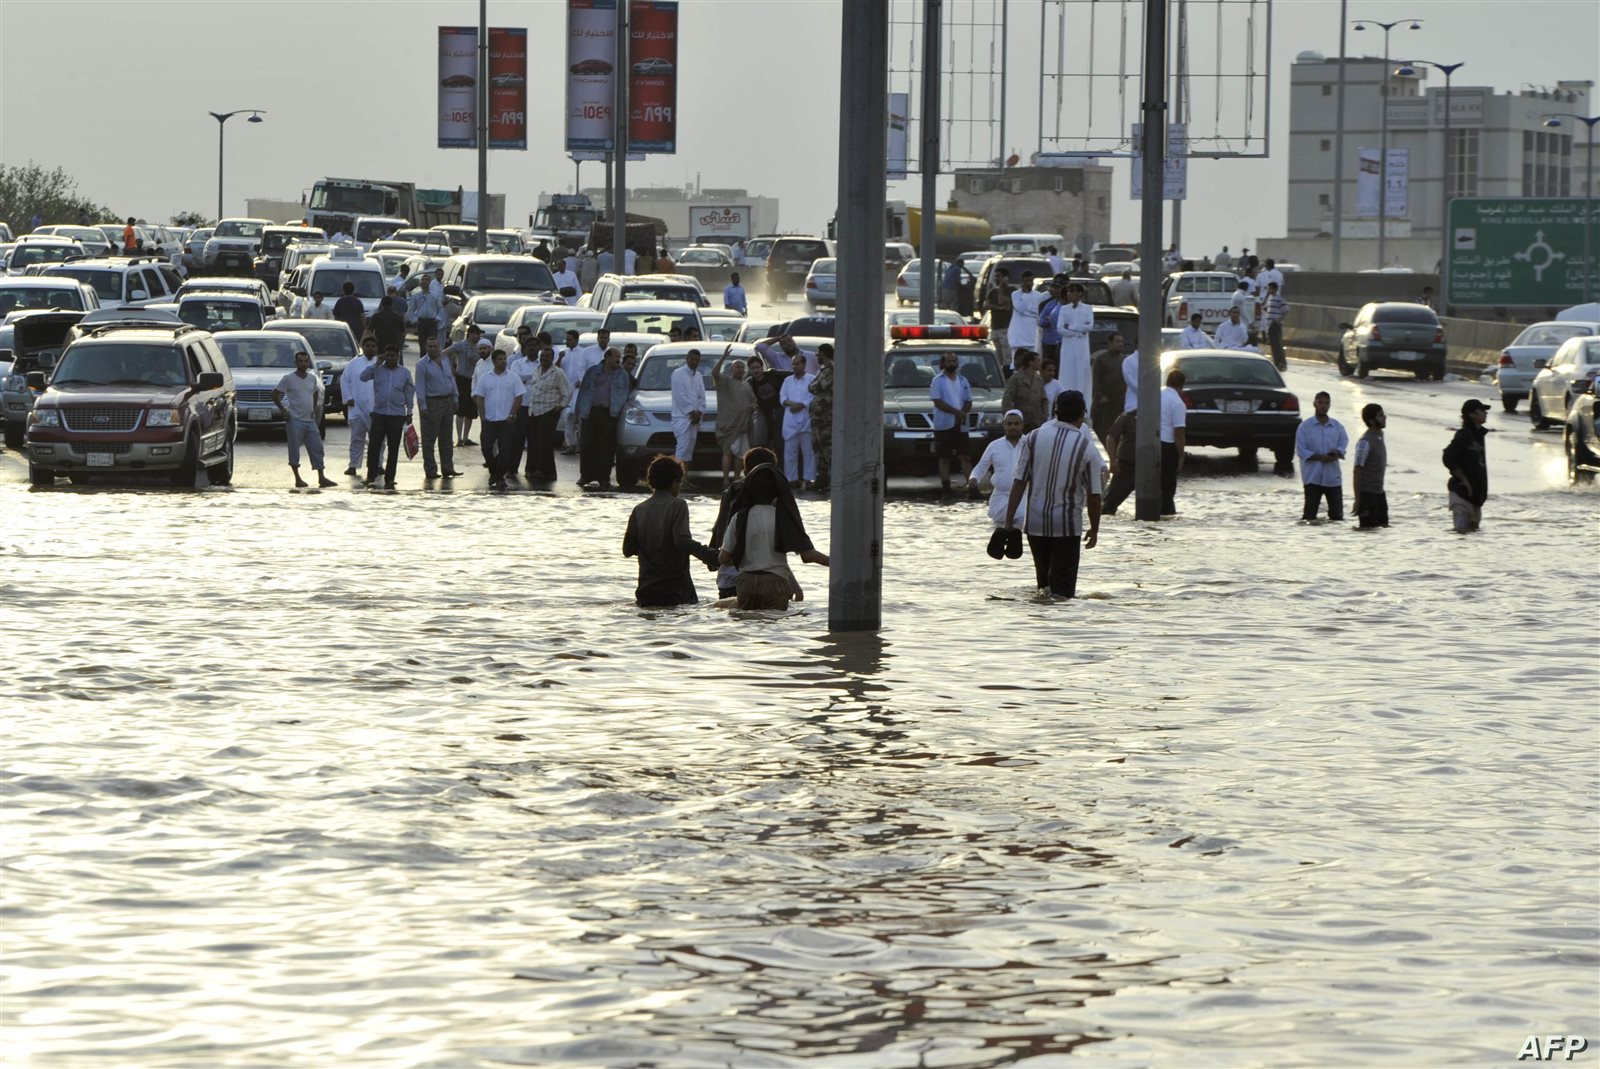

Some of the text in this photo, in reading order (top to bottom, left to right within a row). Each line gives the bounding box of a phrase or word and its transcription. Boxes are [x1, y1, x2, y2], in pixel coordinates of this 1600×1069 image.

[1508, 203, 1525, 213] الله
[1527, 206, 1546, 214] عبد
[1549, 204, 1576, 213] الملك
[1480, 216, 1503, 224] KING
[1505, 216, 1554, 224] ABDULLAH
[1453, 256, 1511, 267] طريق الملك
[1494, 268, 1512, 280] فهد
